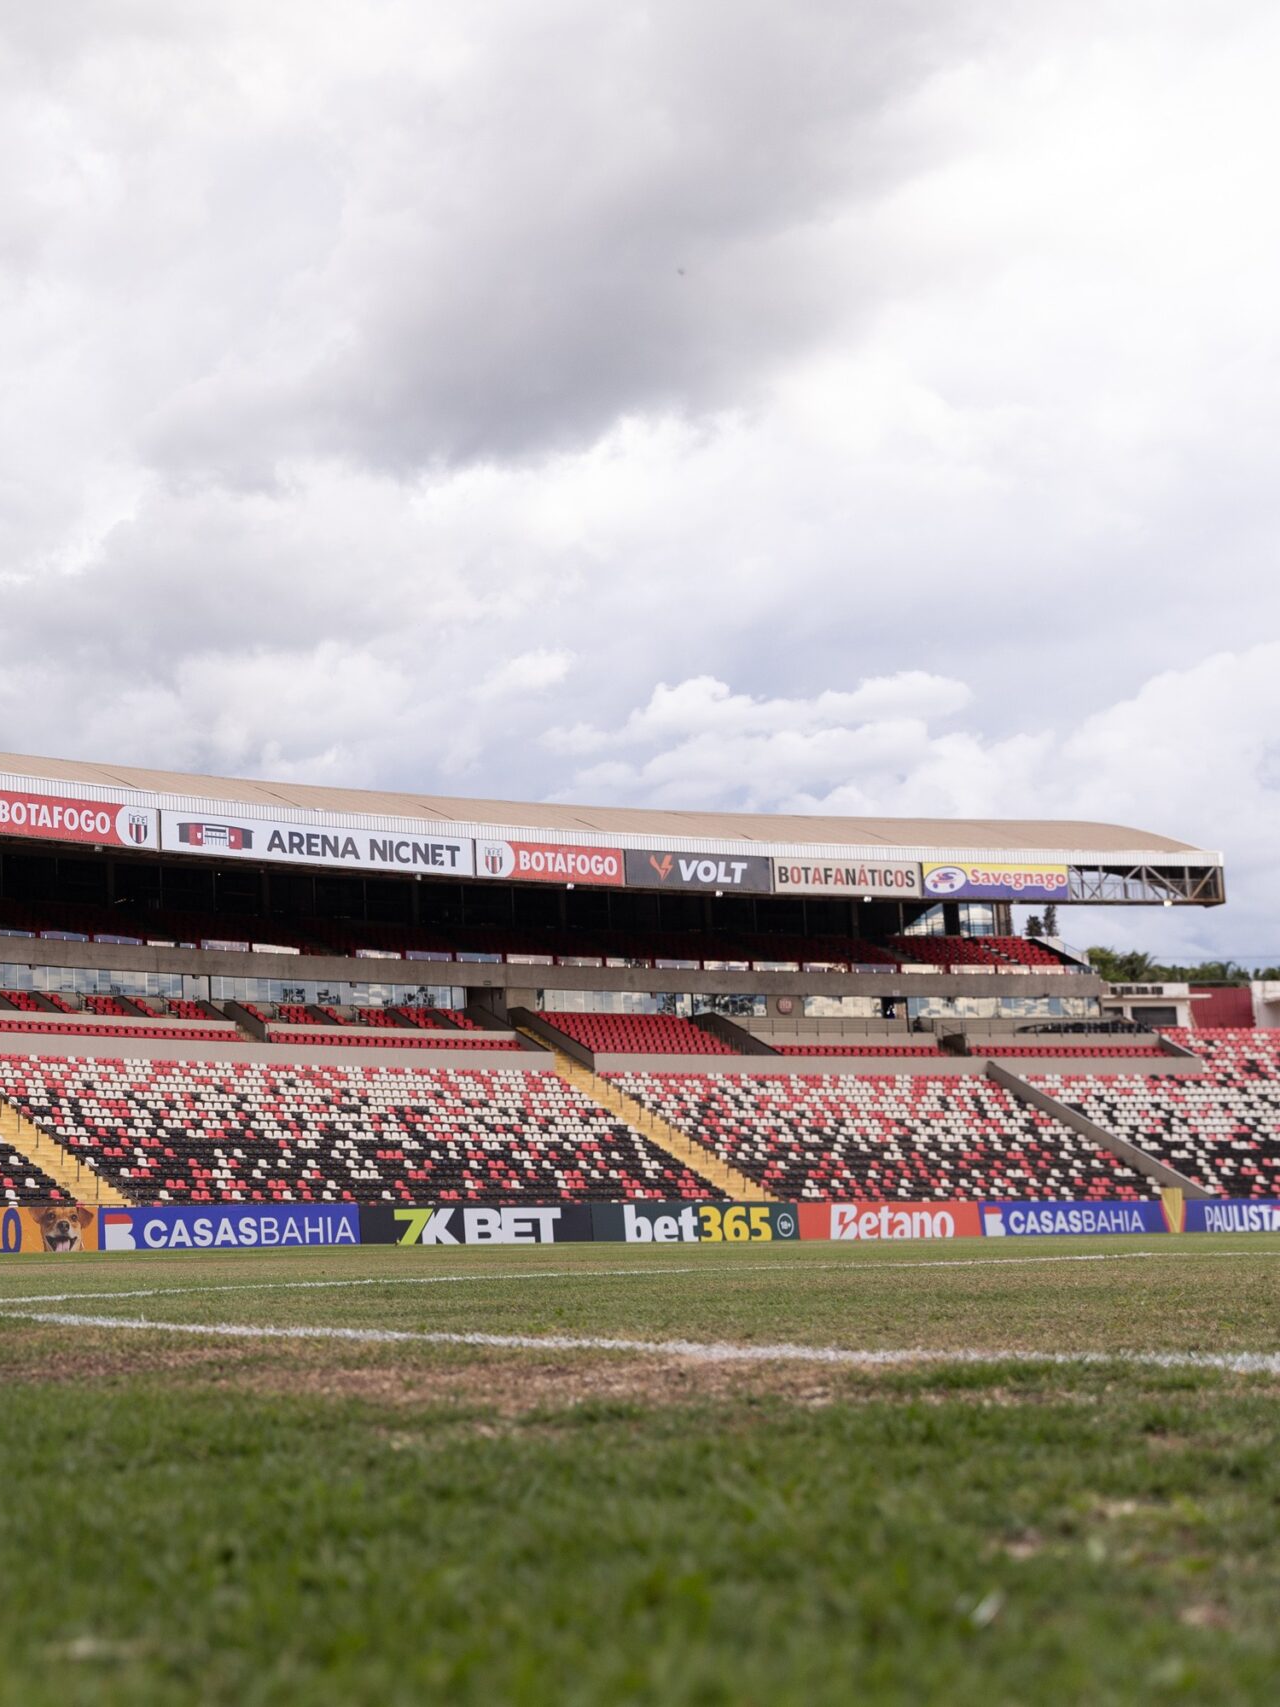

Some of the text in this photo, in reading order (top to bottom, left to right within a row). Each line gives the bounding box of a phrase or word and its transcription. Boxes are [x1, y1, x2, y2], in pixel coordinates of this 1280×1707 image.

[267, 829, 460, 868] ARENA NICNET
[519, 849, 618, 877] BOTAFOGO
[678, 858, 747, 884] VOLT
[778, 865, 915, 888] BOTAFANÁTICOS
[970, 868, 1067, 890] Savegnago
[623, 1204, 773, 1242] bet365
[830, 1203, 955, 1240] Betano
